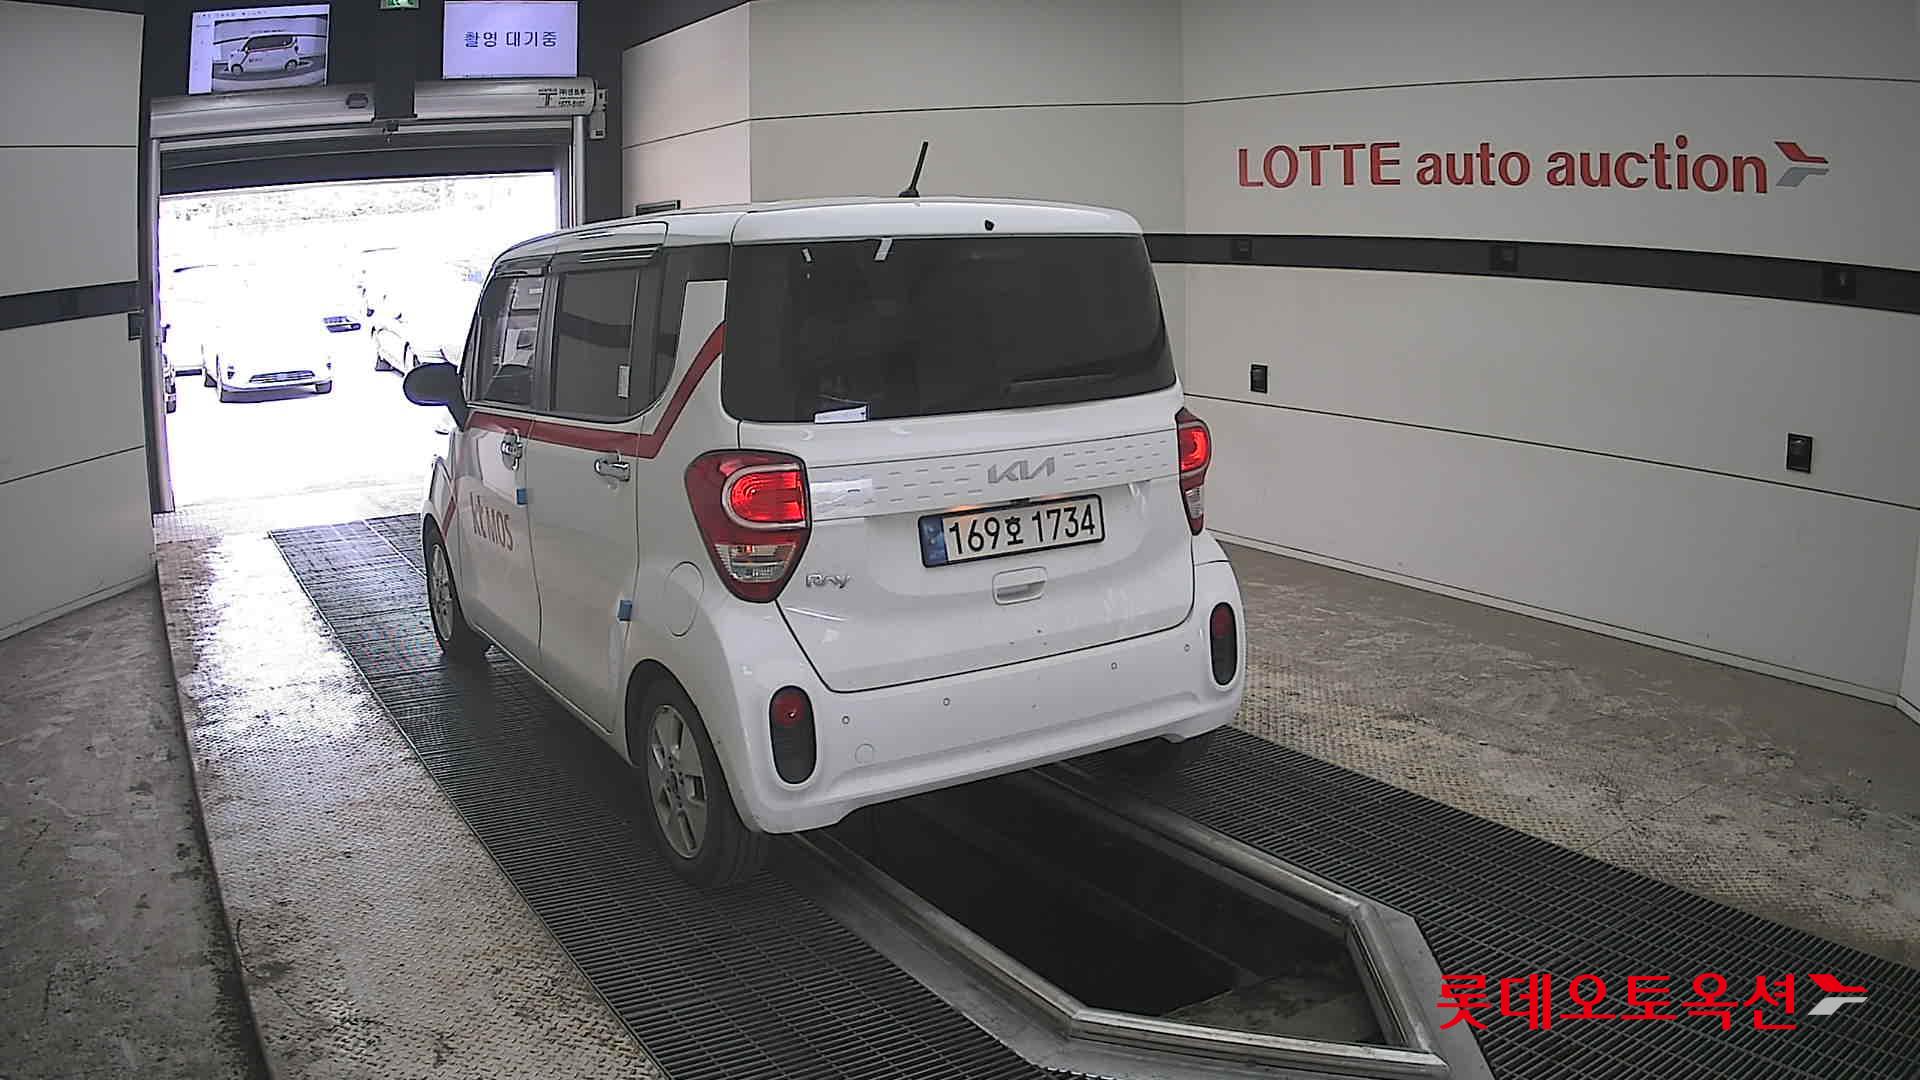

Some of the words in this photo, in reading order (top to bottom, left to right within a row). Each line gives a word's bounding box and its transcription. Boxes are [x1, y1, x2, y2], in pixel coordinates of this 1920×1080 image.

[1239, 143, 1400, 188] LOTTE
[1418, 143, 1531, 187] auto
[1546, 135, 1767, 194] auction
[949, 515, 1024, 555] 169호
[1031, 503, 1096, 543] 1734
